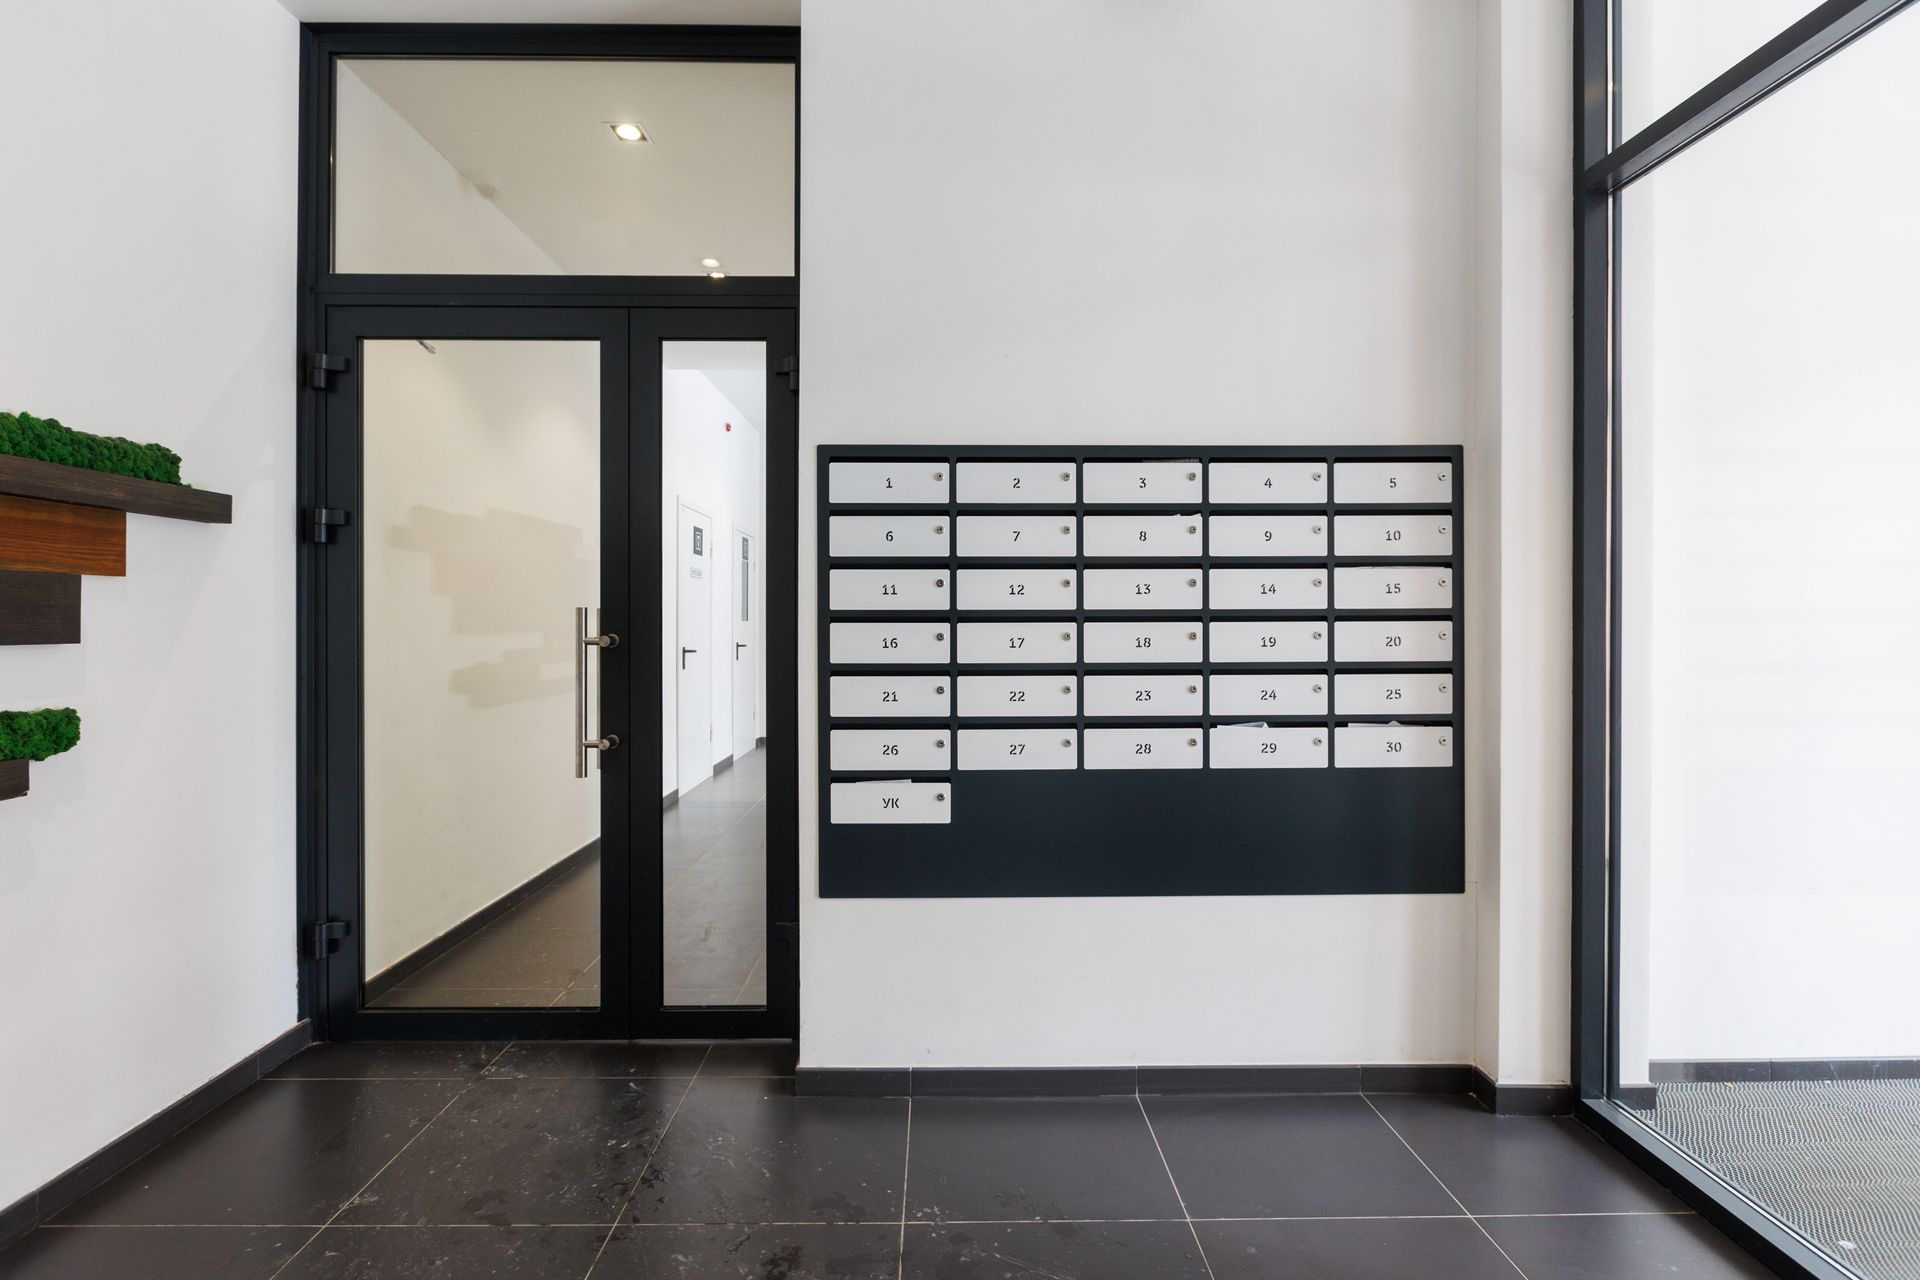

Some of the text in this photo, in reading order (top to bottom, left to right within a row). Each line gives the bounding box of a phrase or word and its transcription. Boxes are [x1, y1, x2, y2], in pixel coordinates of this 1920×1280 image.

[885, 477, 893, 489] 1
[1012, 477, 1021, 489] 2
[1138, 477, 1147, 489] 3
[1263, 477, 1273, 489] 4
[1389, 477, 1397, 489] 5
[885, 530, 894, 542] 6
[1012, 530, 1021, 542] 7
[1138, 530, 1147, 542] 8
[1264, 530, 1273, 542] 9
[1385, 530, 1402, 542] 10
[882, 584, 898, 596] 11
[1008, 584, 1025, 596] 12
[1135, 583, 1151, 595] 13
[1260, 583, 1277, 595] 14
[1385, 582, 1401, 595] 15
[882, 637, 899, 649] 16
[1009, 637, 1025, 649] 17
[1135, 636, 1152, 649] 18
[1260, 636, 1277, 648] 19
[1385, 635, 1402, 648] 20
[882, 690, 899, 703] 21
[1009, 690, 1026, 702] 22
[1135, 690, 1152, 702] 23
[1260, 689, 1277, 701] 24
[1385, 688, 1402, 700] 25
[882, 744, 899, 756] 26
[1009, 743, 1026, 756] 27
[1135, 743, 1152, 755] 28
[1260, 742, 1277, 754] 29
[1386, 741, 1402, 753] 30
[882, 797, 900, 809] УК
